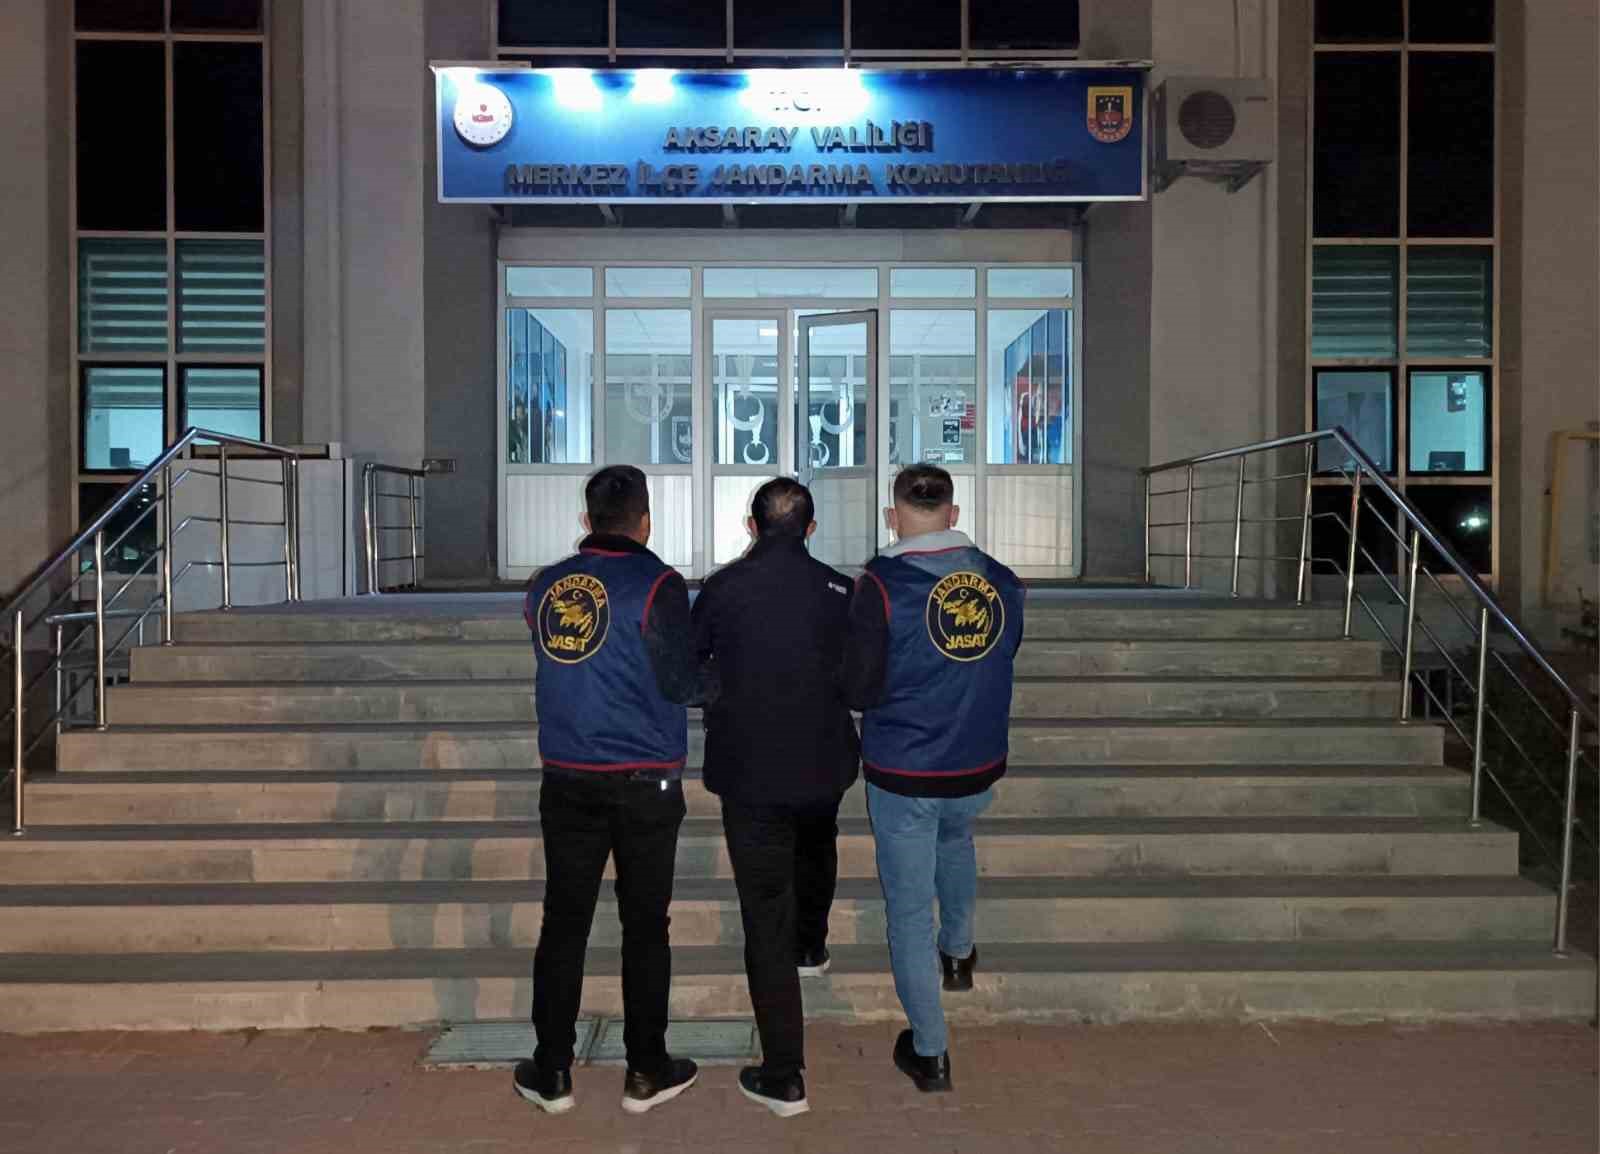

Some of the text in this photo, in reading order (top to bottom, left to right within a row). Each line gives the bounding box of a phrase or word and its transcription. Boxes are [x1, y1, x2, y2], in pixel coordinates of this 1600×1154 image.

[665, 126, 797, 149] AKSARAY
[506, 163, 627, 187] MERKEZ
[710, 163, 873, 187] JANDARMA
[932, 575, 997, 604] JANDARMA
